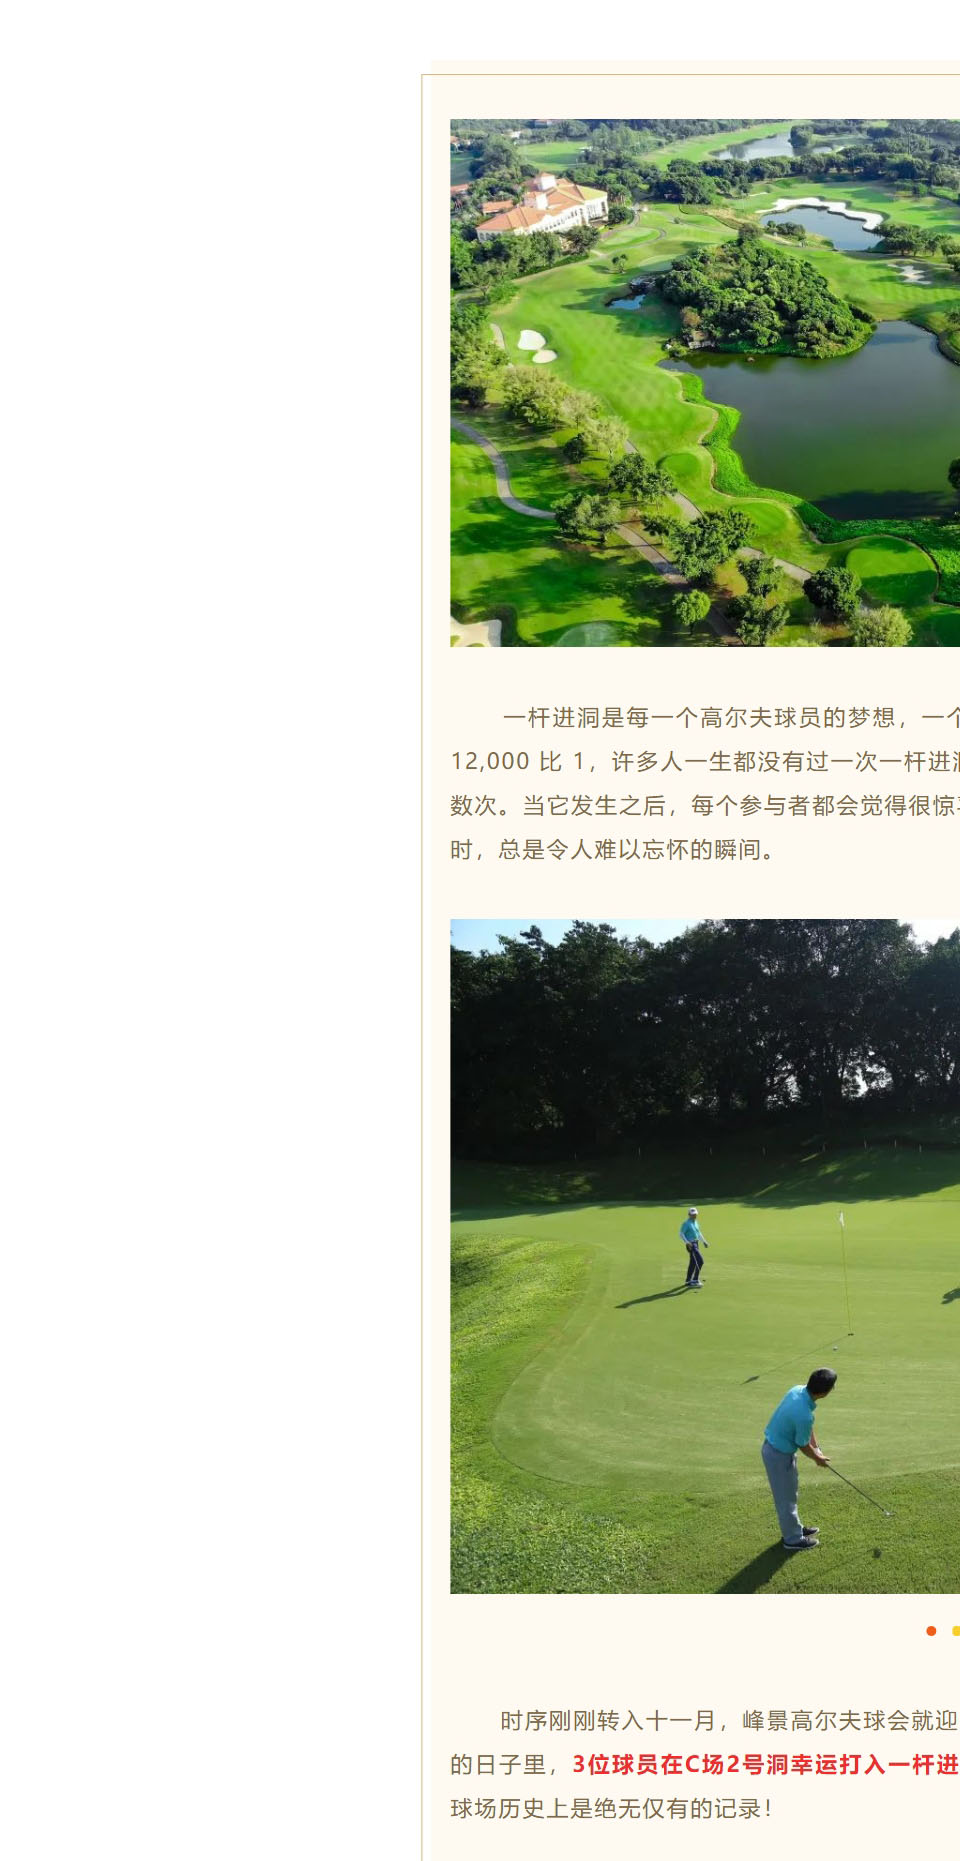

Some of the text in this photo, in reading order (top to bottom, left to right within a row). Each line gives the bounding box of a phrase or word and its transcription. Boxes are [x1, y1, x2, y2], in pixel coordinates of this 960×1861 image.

[451, 751, 530, 773] 12,000
[539, 750, 563, 773] 比
[450, 837, 771, 862] 时，总是令人难以忘怀的瞬间。
[450, 1796, 771, 1821] 球场历史上是绝无仅有的记录！
